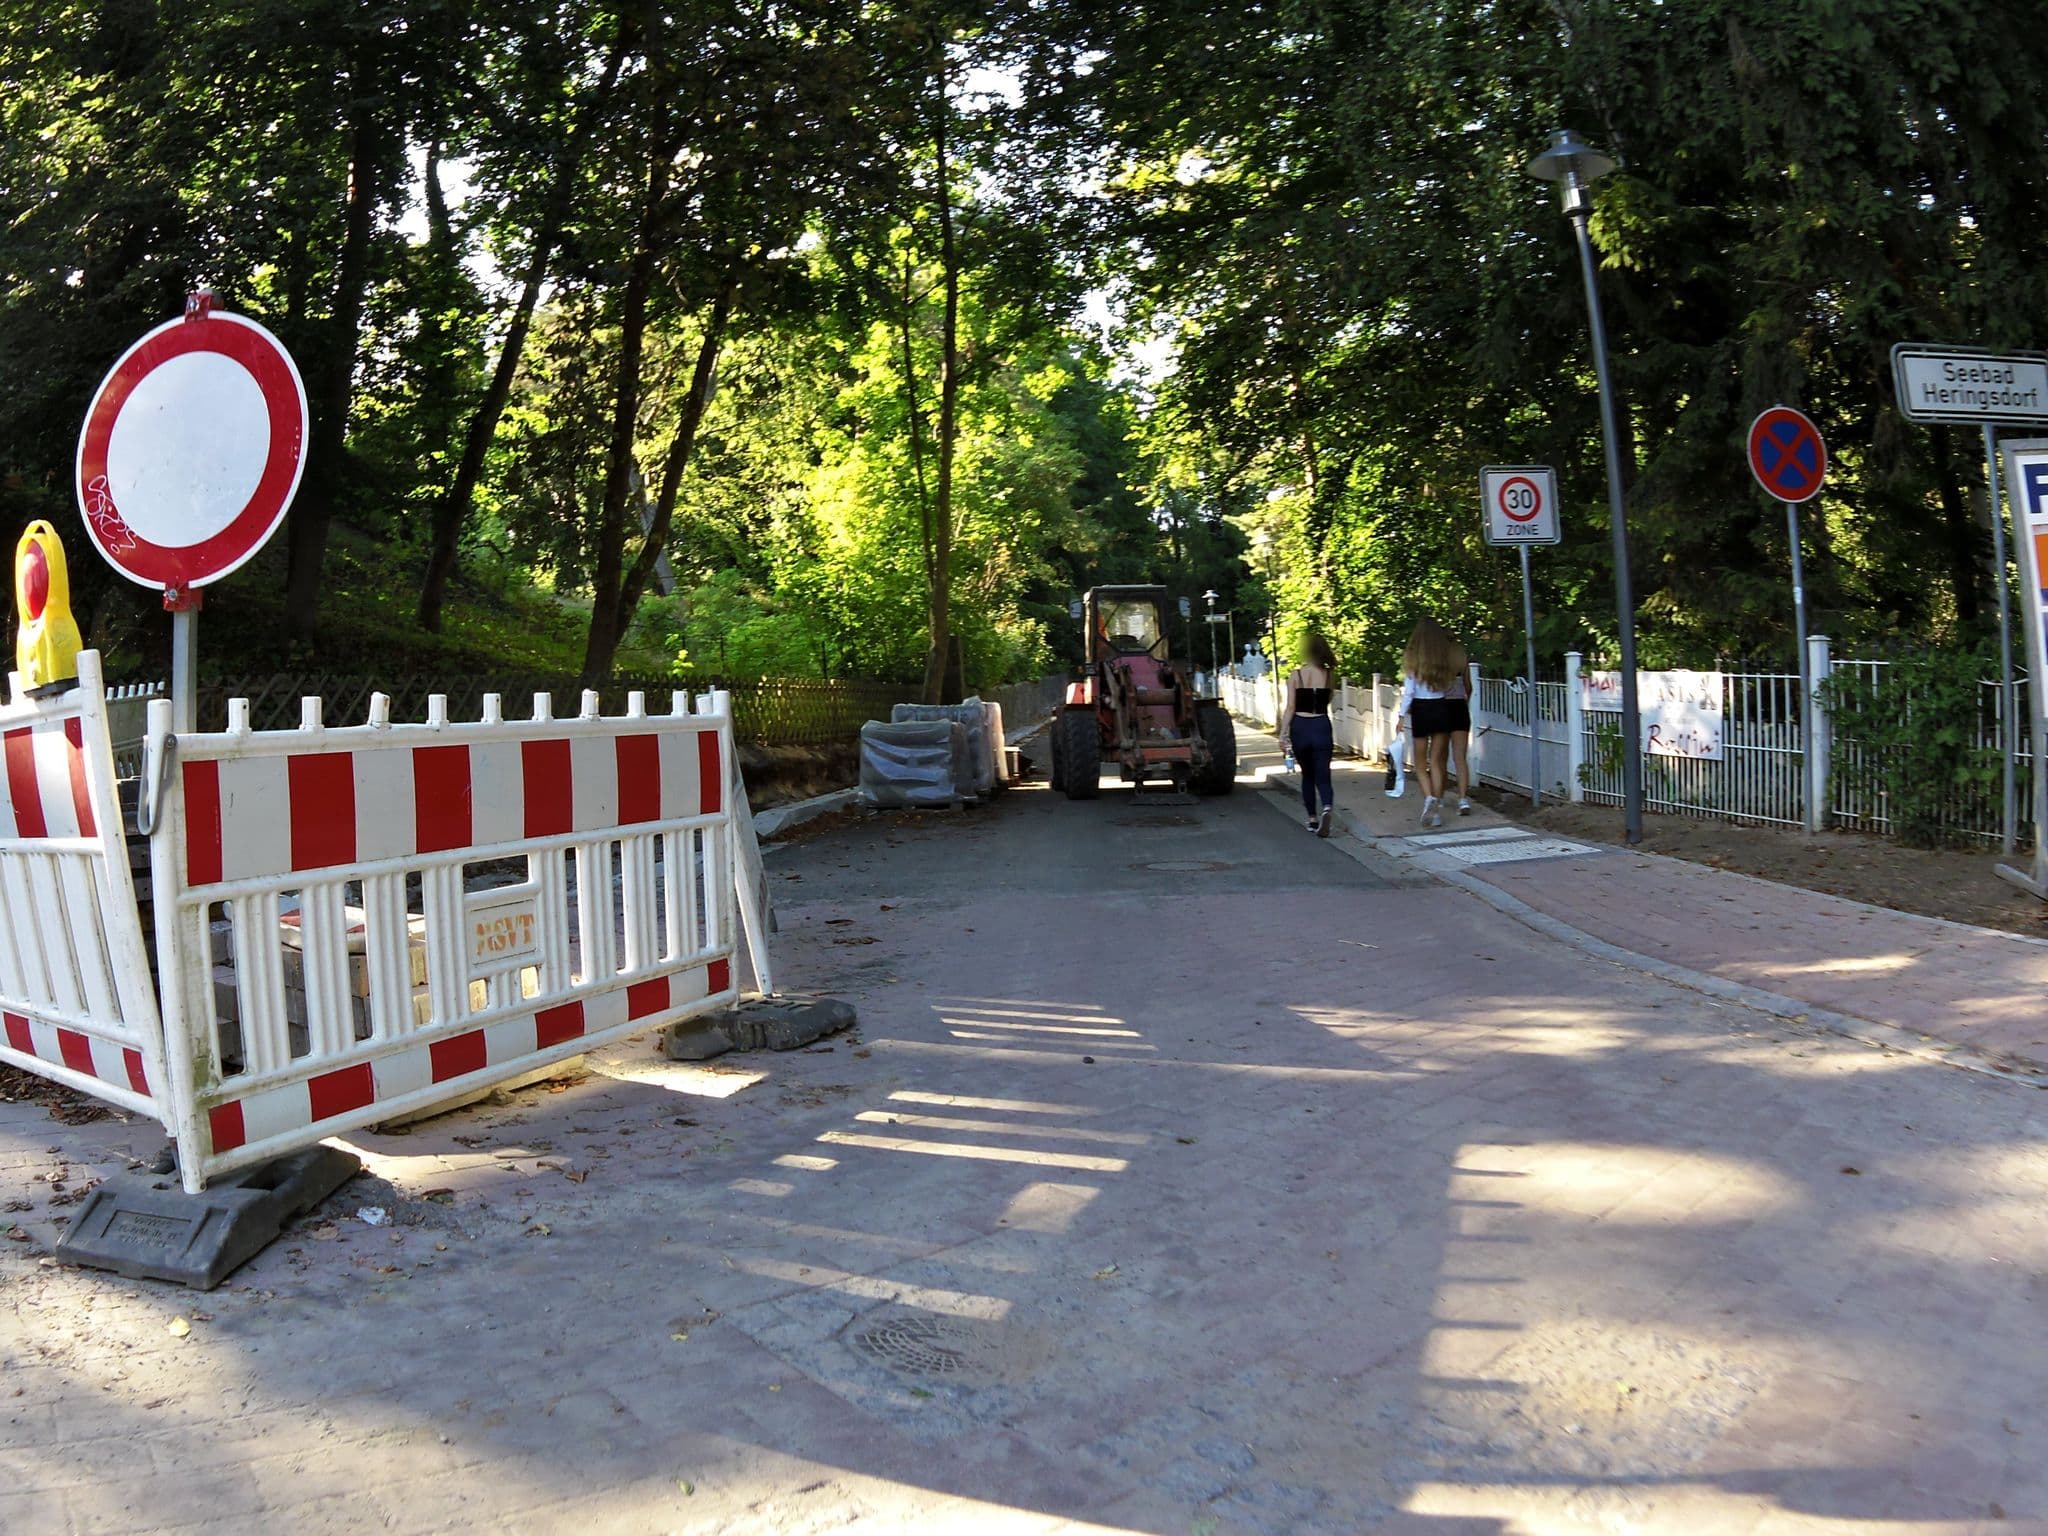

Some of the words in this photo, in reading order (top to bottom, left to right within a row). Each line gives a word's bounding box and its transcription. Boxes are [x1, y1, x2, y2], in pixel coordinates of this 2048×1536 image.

[1943, 362, 2015, 384] Seebad
[1922, 383, 2038, 410] Heringsdorf
[1507, 489, 1533, 509] 30
[1506, 524, 1540, 536] ZONE
